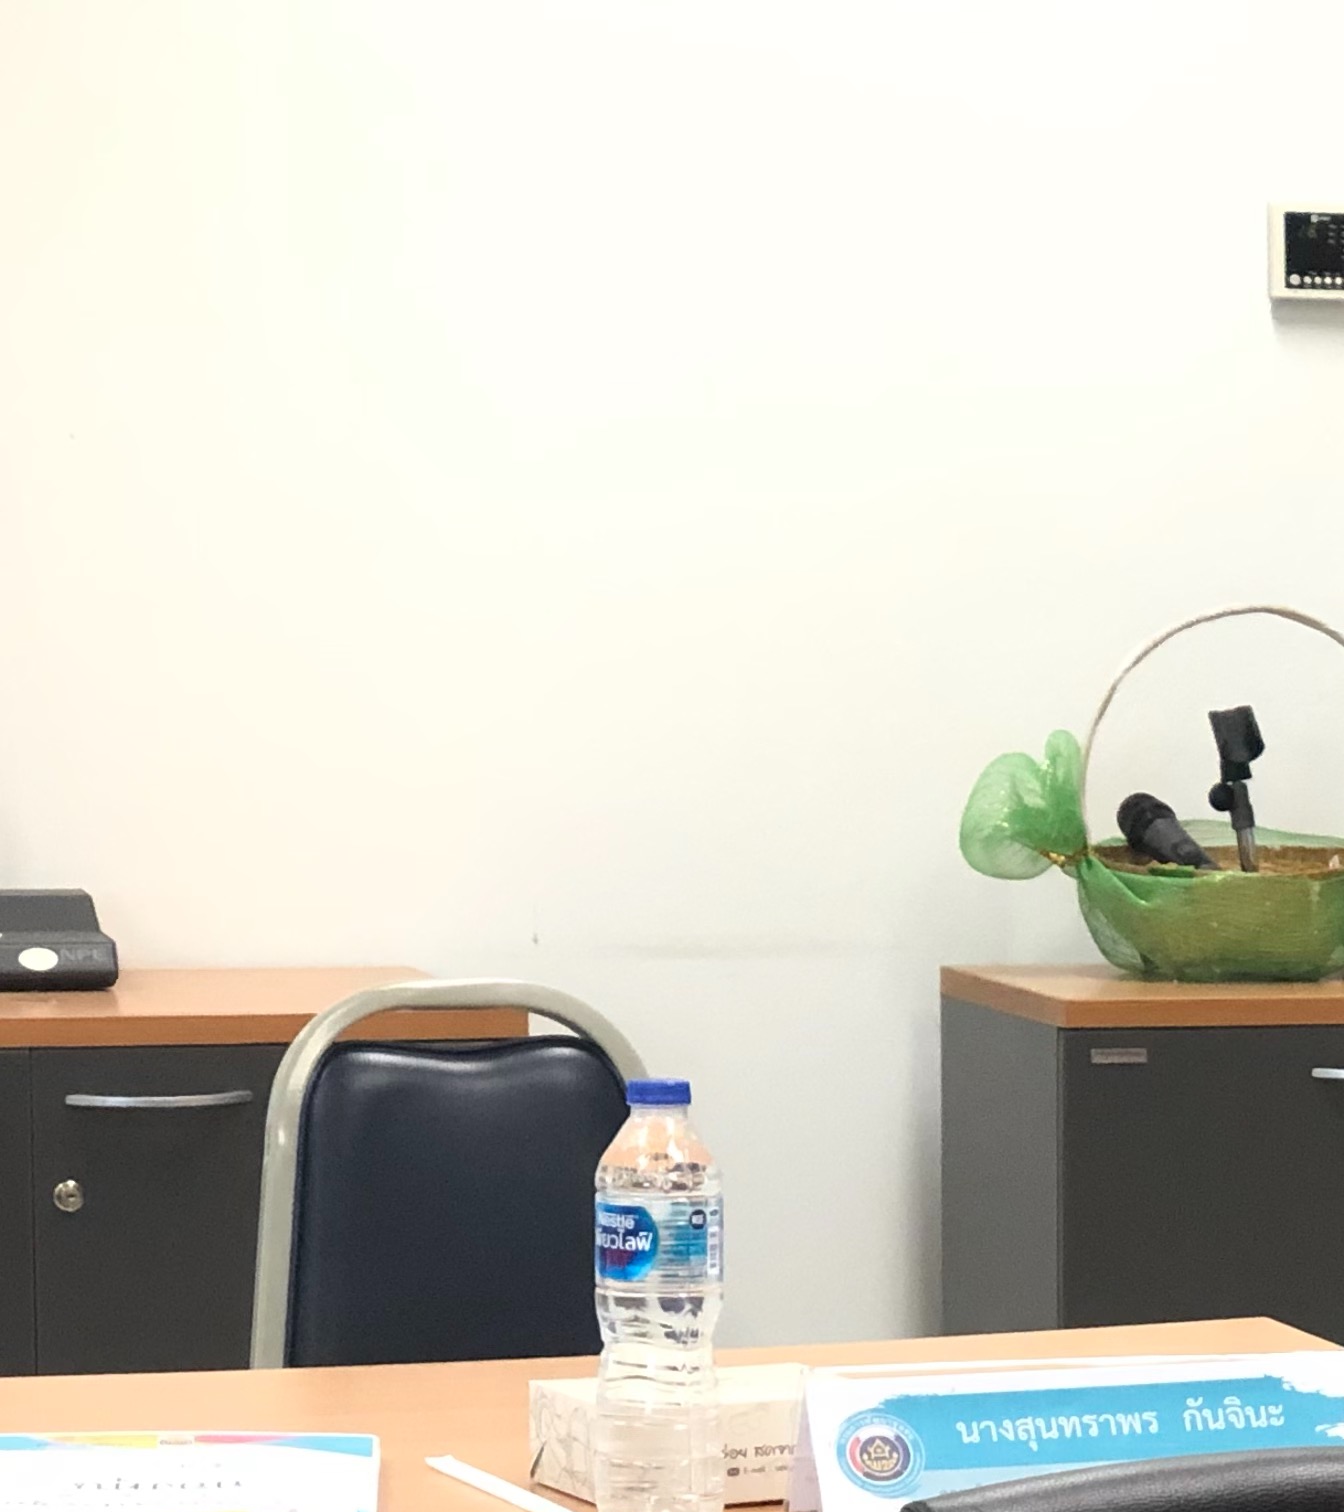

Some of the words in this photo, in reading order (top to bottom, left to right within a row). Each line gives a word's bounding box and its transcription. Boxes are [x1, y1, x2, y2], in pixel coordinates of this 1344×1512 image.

[956, 1410, 1159, 1452] นางสุนทราพร
[1183, 1396, 1285, 1432] กันจินะ
